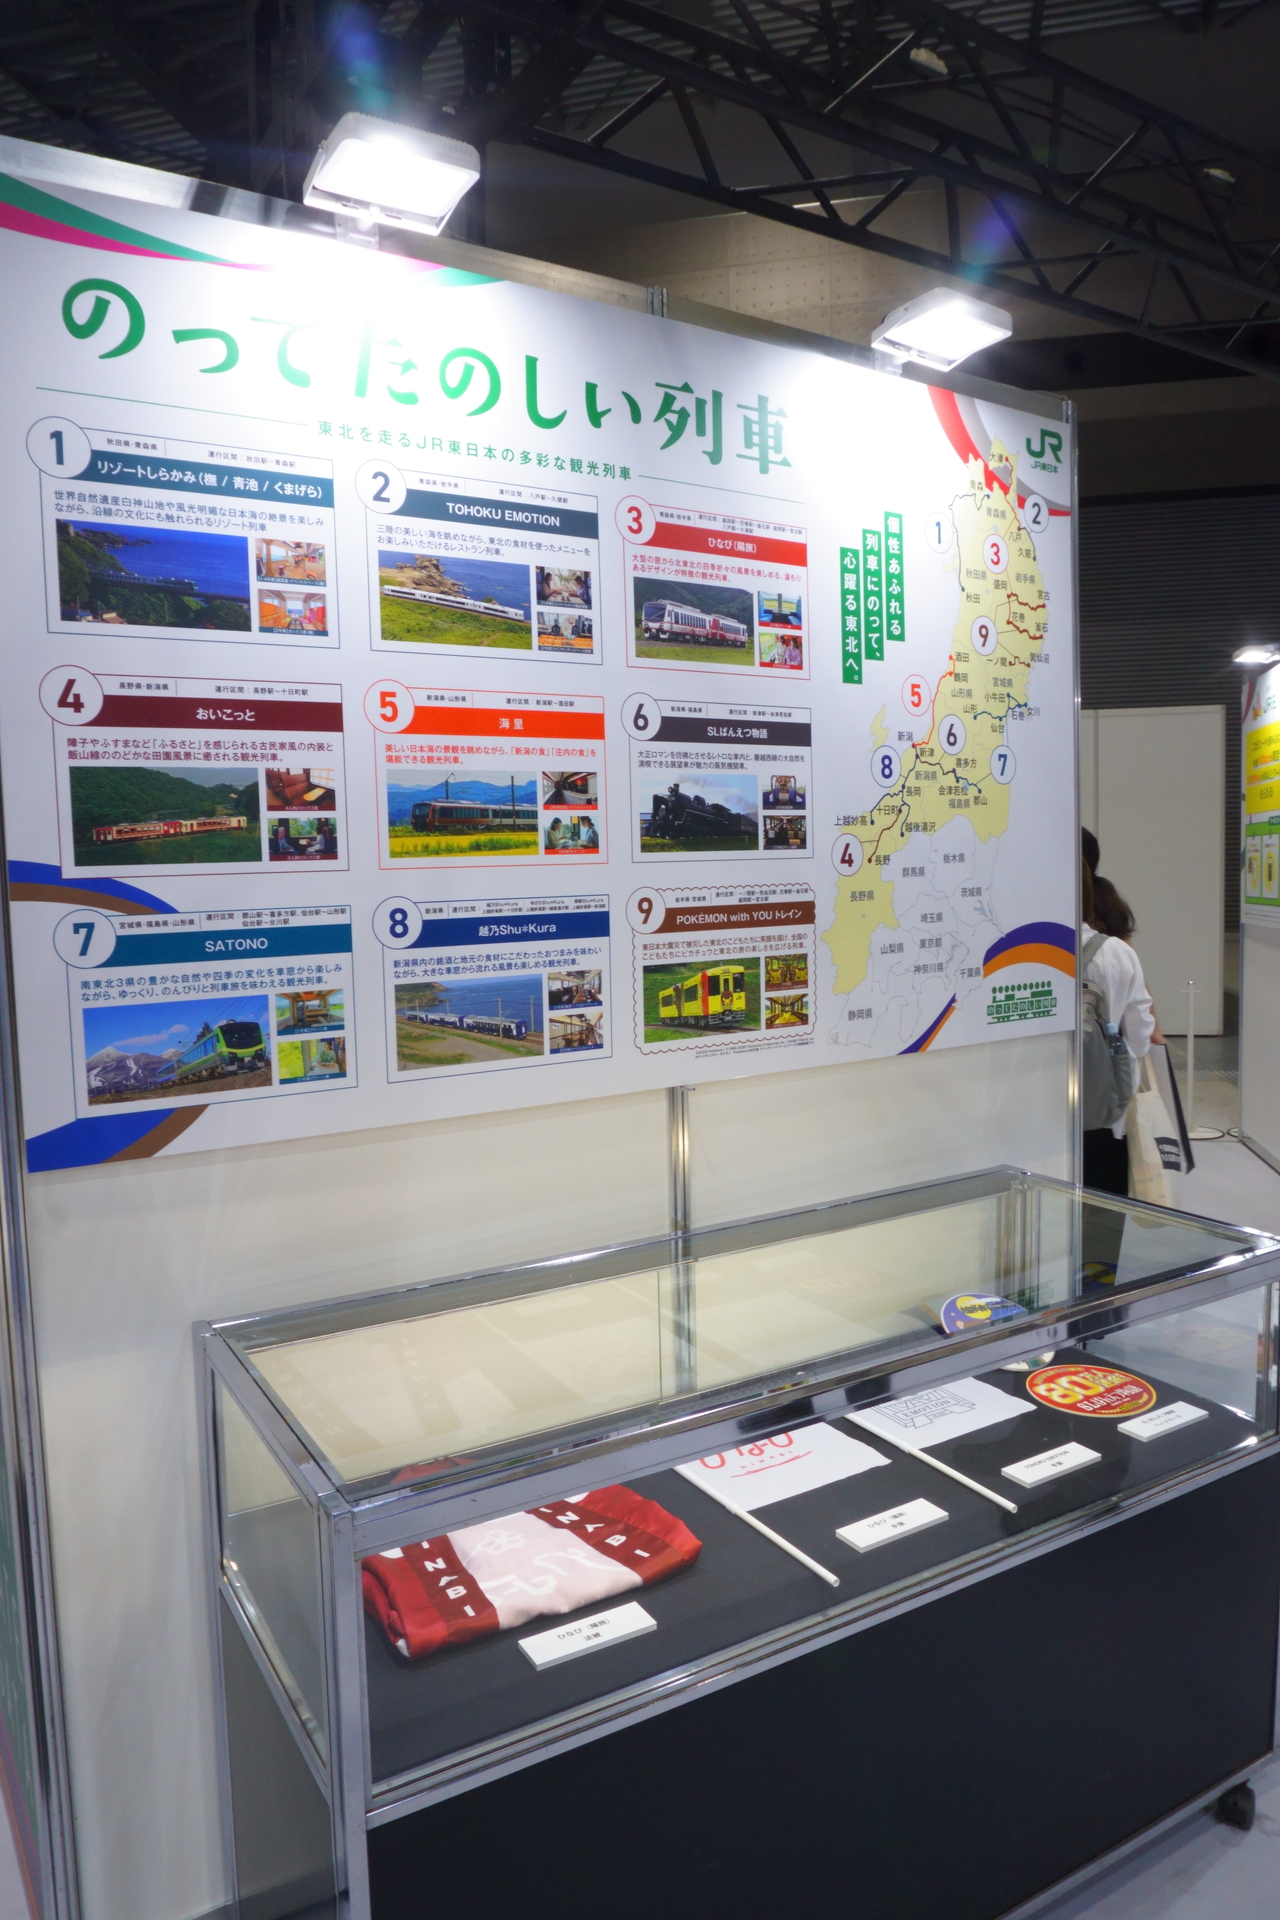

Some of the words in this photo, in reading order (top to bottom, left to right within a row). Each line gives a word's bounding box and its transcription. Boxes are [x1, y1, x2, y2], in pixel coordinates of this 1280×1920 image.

[62, 278, 793, 475] のってたのしい列車
[49, 430, 64, 465] 1
[106, 438, 158, 450] 秋田県・青森県
[317, 420, 632, 480] 東北を走るJR東日本の多彩な観光列車
[1026, 428, 1063, 464] JR
[989, 452, 1004, 464] 大湊
[1031, 461, 1059, 474] JR東日本
[233, 476, 259, 492] 青池
[372, 471, 390, 503] 2
[419, 478, 459, 489] 青森県・岩手県
[970, 480, 984, 491] 青森
[54, 489, 324, 526] 世界自然遺産白神山地や風光明媚な日本海の絶景を楽しみ
[986, 507, 1007, 520] 青森県
[1031, 502, 1041, 525] 2
[54, 502, 267, 532] ながら、沿線の文化にも触れられるリゾート列車
[446, 502, 501, 519] TOHOKU
[505, 510, 560, 527] EMOTION
[627, 506, 643, 534] 3
[935, 521, 941, 544] 1
[1008, 532, 1022, 541] 八戸
[377, 524, 591, 556] 三陸の美しい海を眺めながら、東北の食材を使ったメニューを
[377, 536, 505, 557] お楽しみいただけるレストラン列車。
[990, 542, 1000, 565] 3
[632, 554, 801, 582] 大型の窓から北東北の四季折々の風景を楽しめる、温もり
[632, 564, 731, 582] あるデザインが特徴の観光列車。
[965, 568, 987, 581] 秋田県
[887, 516, 901, 635] 個性あふれる
[1015, 572, 1036, 585] 岩手県
[994, 579, 1008, 591] 盛岡
[865, 533, 880, 657] 列車にのって、
[965, 593, 980, 604] 秋田
[1037, 590, 1050, 600] 宮古
[843, 552, 859, 681] 心躍る東北へ。
[1011, 612, 1025, 623] 花巻
[1035, 622, 1048, 632] 釜石
[978, 624, 989, 647] 9
[954, 651, 969, 662] 酒田
[953, 672, 968, 683] 鶴岡
[992, 677, 1013, 688] 宮城県
[118, 682, 169, 691] 長野県・新潟県
[57, 678, 85, 713] 4
[426, 695, 467, 703] 新潟県・山形県
[910, 683, 922, 708] 5
[951, 688, 973, 699] 山形県
[984, 693, 1006, 703] 小牛田
[379, 691, 398, 723] 5
[963, 703, 978, 714] 山形
[1027, 707, 1040, 716] 女川
[196, 707, 256, 722] おいこっと
[633, 703, 649, 731] 6
[1011, 710, 1025, 721] 石巻
[499, 717, 524, 730] 海里
[990, 723, 1005, 733] 仙台
[707, 727, 768, 738] SLばんえつ物語
[898, 731, 913, 742] 新潟
[946, 723, 957, 746] 6
[67, 738, 334, 752] 障子やふすまなど「ふるさと」を感じられる古民家風の内装と
[385, 744, 597, 757] 美しい日本海の景観を眺めながら、「新潟の食」「庄内の食」を
[68, 750, 283, 762] 飯山線ののどかな田園風景に癒される観光列車。
[920, 748, 934, 758] 新津
[385, 755, 463, 765] 堪能できる観光列車。
[955, 758, 977, 768] 喜多方
[998, 753, 1008, 776] 7
[881, 755, 893, 779] 8
[915, 770, 938, 781] 新潟県
[906, 786, 921, 797] 長岡
[938, 785, 968, 796] 会津若松
[948, 798, 971, 809] 福島県
[973, 795, 988, 806] 郡山
[876, 805, 899, 815] 十日町
[834, 815, 867, 826] 上越妙高
[905, 822, 936, 833] 越後湯沢
[840, 843, 854, 867] 4
[875, 855, 890, 866] 長野
[943, 853, 965, 863] 栃木県
[902, 866, 926, 878] 群馬県
[850, 890, 874, 902] 長野県
[960, 887, 982, 897] 茨城県
[637, 897, 653, 925] 9
[676, 912, 727, 925] POKÉMON
[730, 912, 750, 921] with
[752, 911, 772, 920] YOU
[775, 909, 802, 919] トレイン
[119, 919, 195, 929] 宮城県・福島県・山形県
[242, 918, 290, 927] 仙台駅～女川駅
[389, 907, 409, 939] 8
[920, 912, 943, 924] 埼玉県
[72, 922, 95, 957] 7
[205, 938, 268, 952] SATONO
[919, 938, 942, 949] 東京都
[642, 942, 807, 960] こどもたちにピカチュウと東北の旅の楽しさを広げる列車。
[880, 943, 904, 955] 山梨県
[393, 947, 601, 968] 新潟県内の銘酒と地元の食材にこだわったおつまみを味わい
[394, 958, 580, 979] ながら、大きな車窓から流れる風景も楽しめる観光列車。
[914, 963, 944, 975] 神奈川県
[960, 967, 981, 978] 千葉県
[81, 964, 342, 990] 南東北3県の豊かな自然や四季の変化を車窓から楽しみ
[81, 976, 328, 1002] ながら、ゆっくり、のんびりと列車旅を味わえる観光列車。
[848, 1008, 873, 1021] 静岡県
[1033, 1375, 1106, 1404] 80
[1076, 1384, 1144, 1411] SLばんえつ物語
[901, 1399, 951, 1418] EMOTION
[740, 1451, 793, 1475] HINABI
